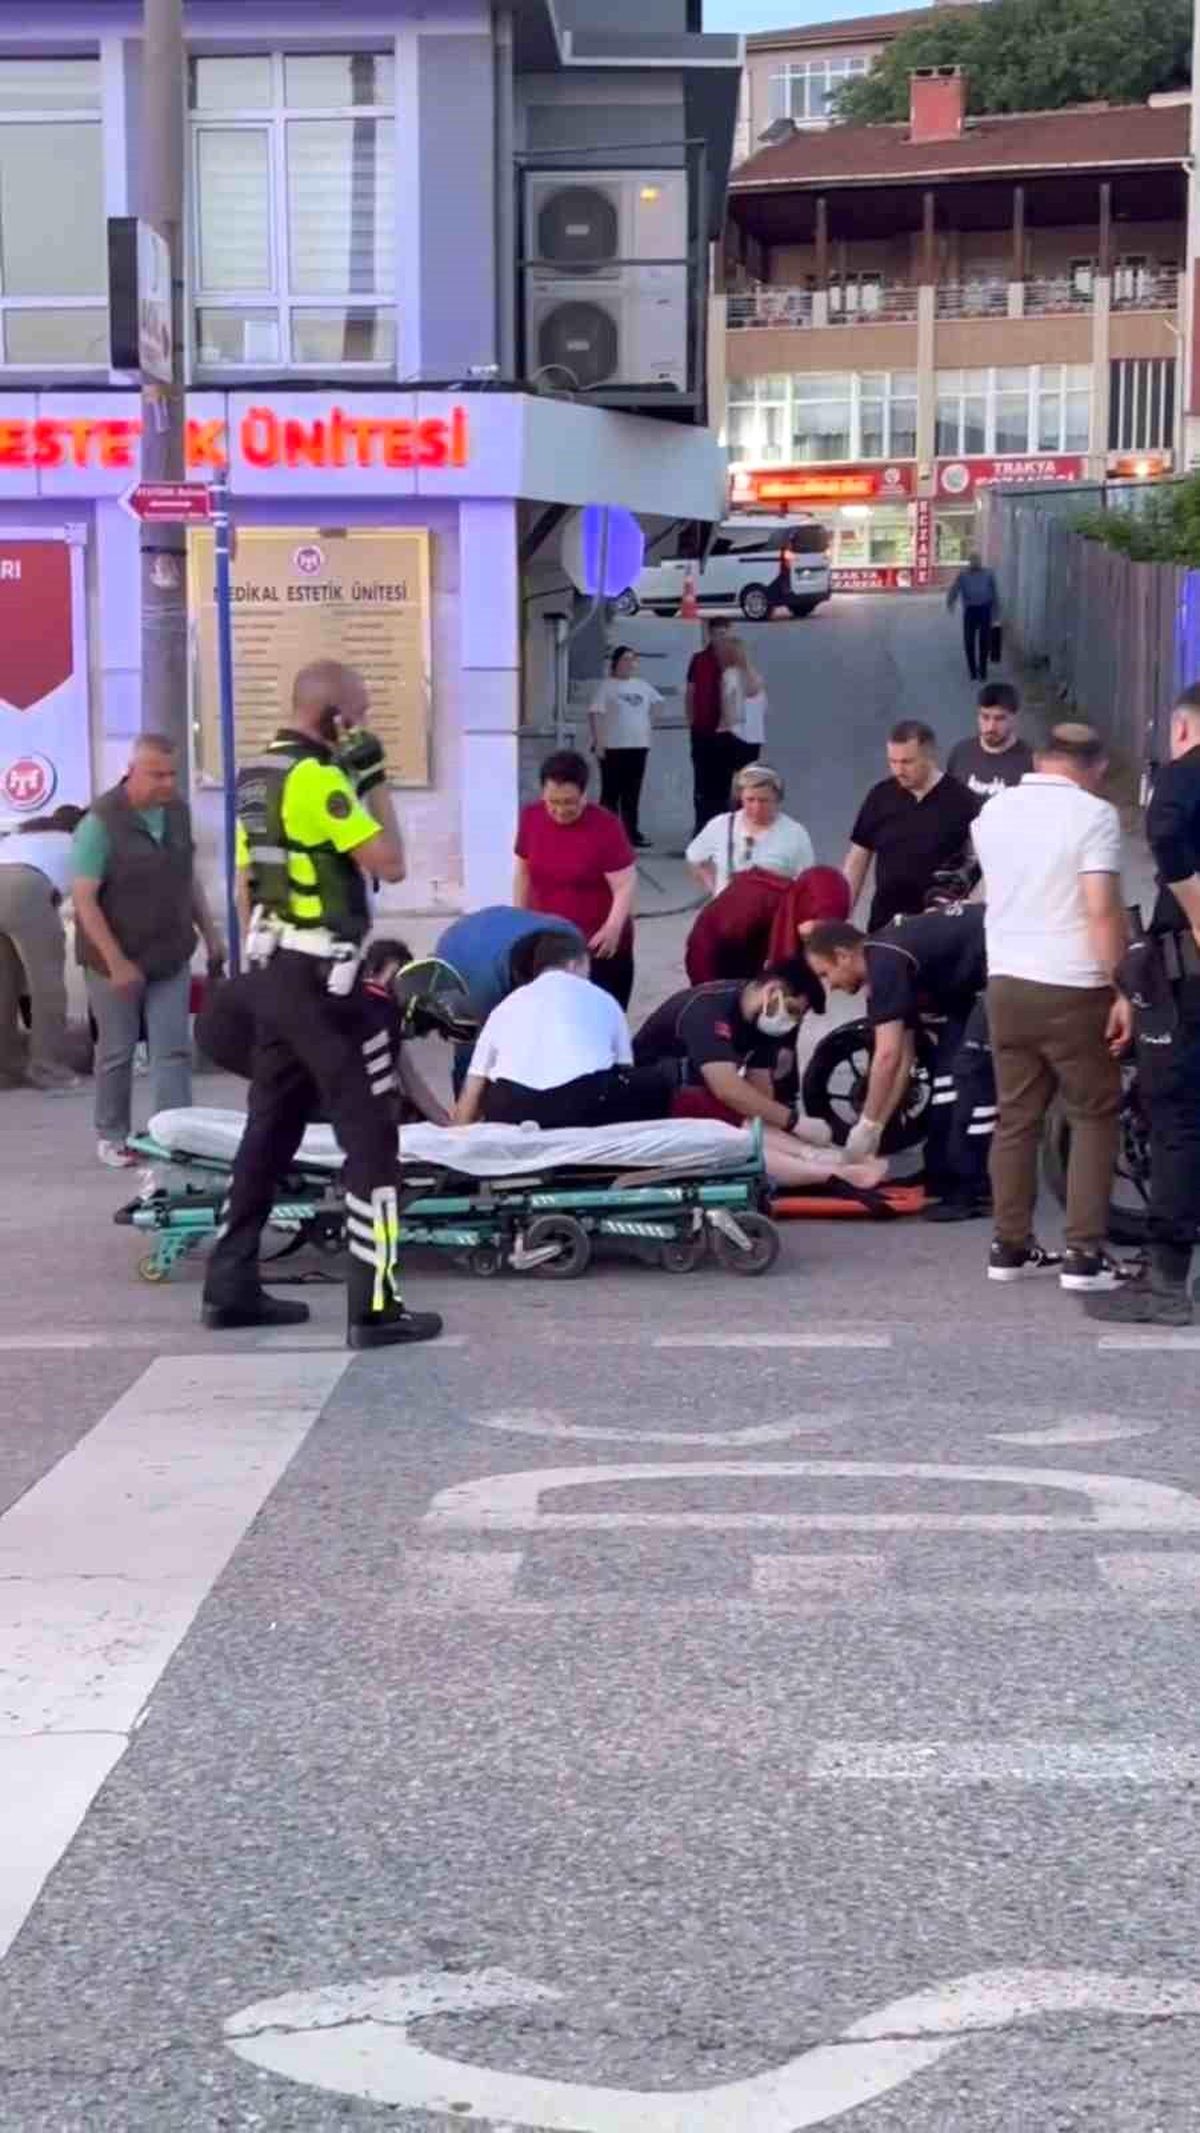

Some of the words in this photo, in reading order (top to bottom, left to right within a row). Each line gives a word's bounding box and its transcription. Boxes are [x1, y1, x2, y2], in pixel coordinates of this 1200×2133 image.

[0, 418, 228, 468] ESTEK
[240, 406, 468, 468] ÜNİTESİ
[993, 461, 1056, 475] TRAKYA
[287, 581, 342, 601] ESTETİK
[352, 580, 407, 600] ÜNİTESİ
